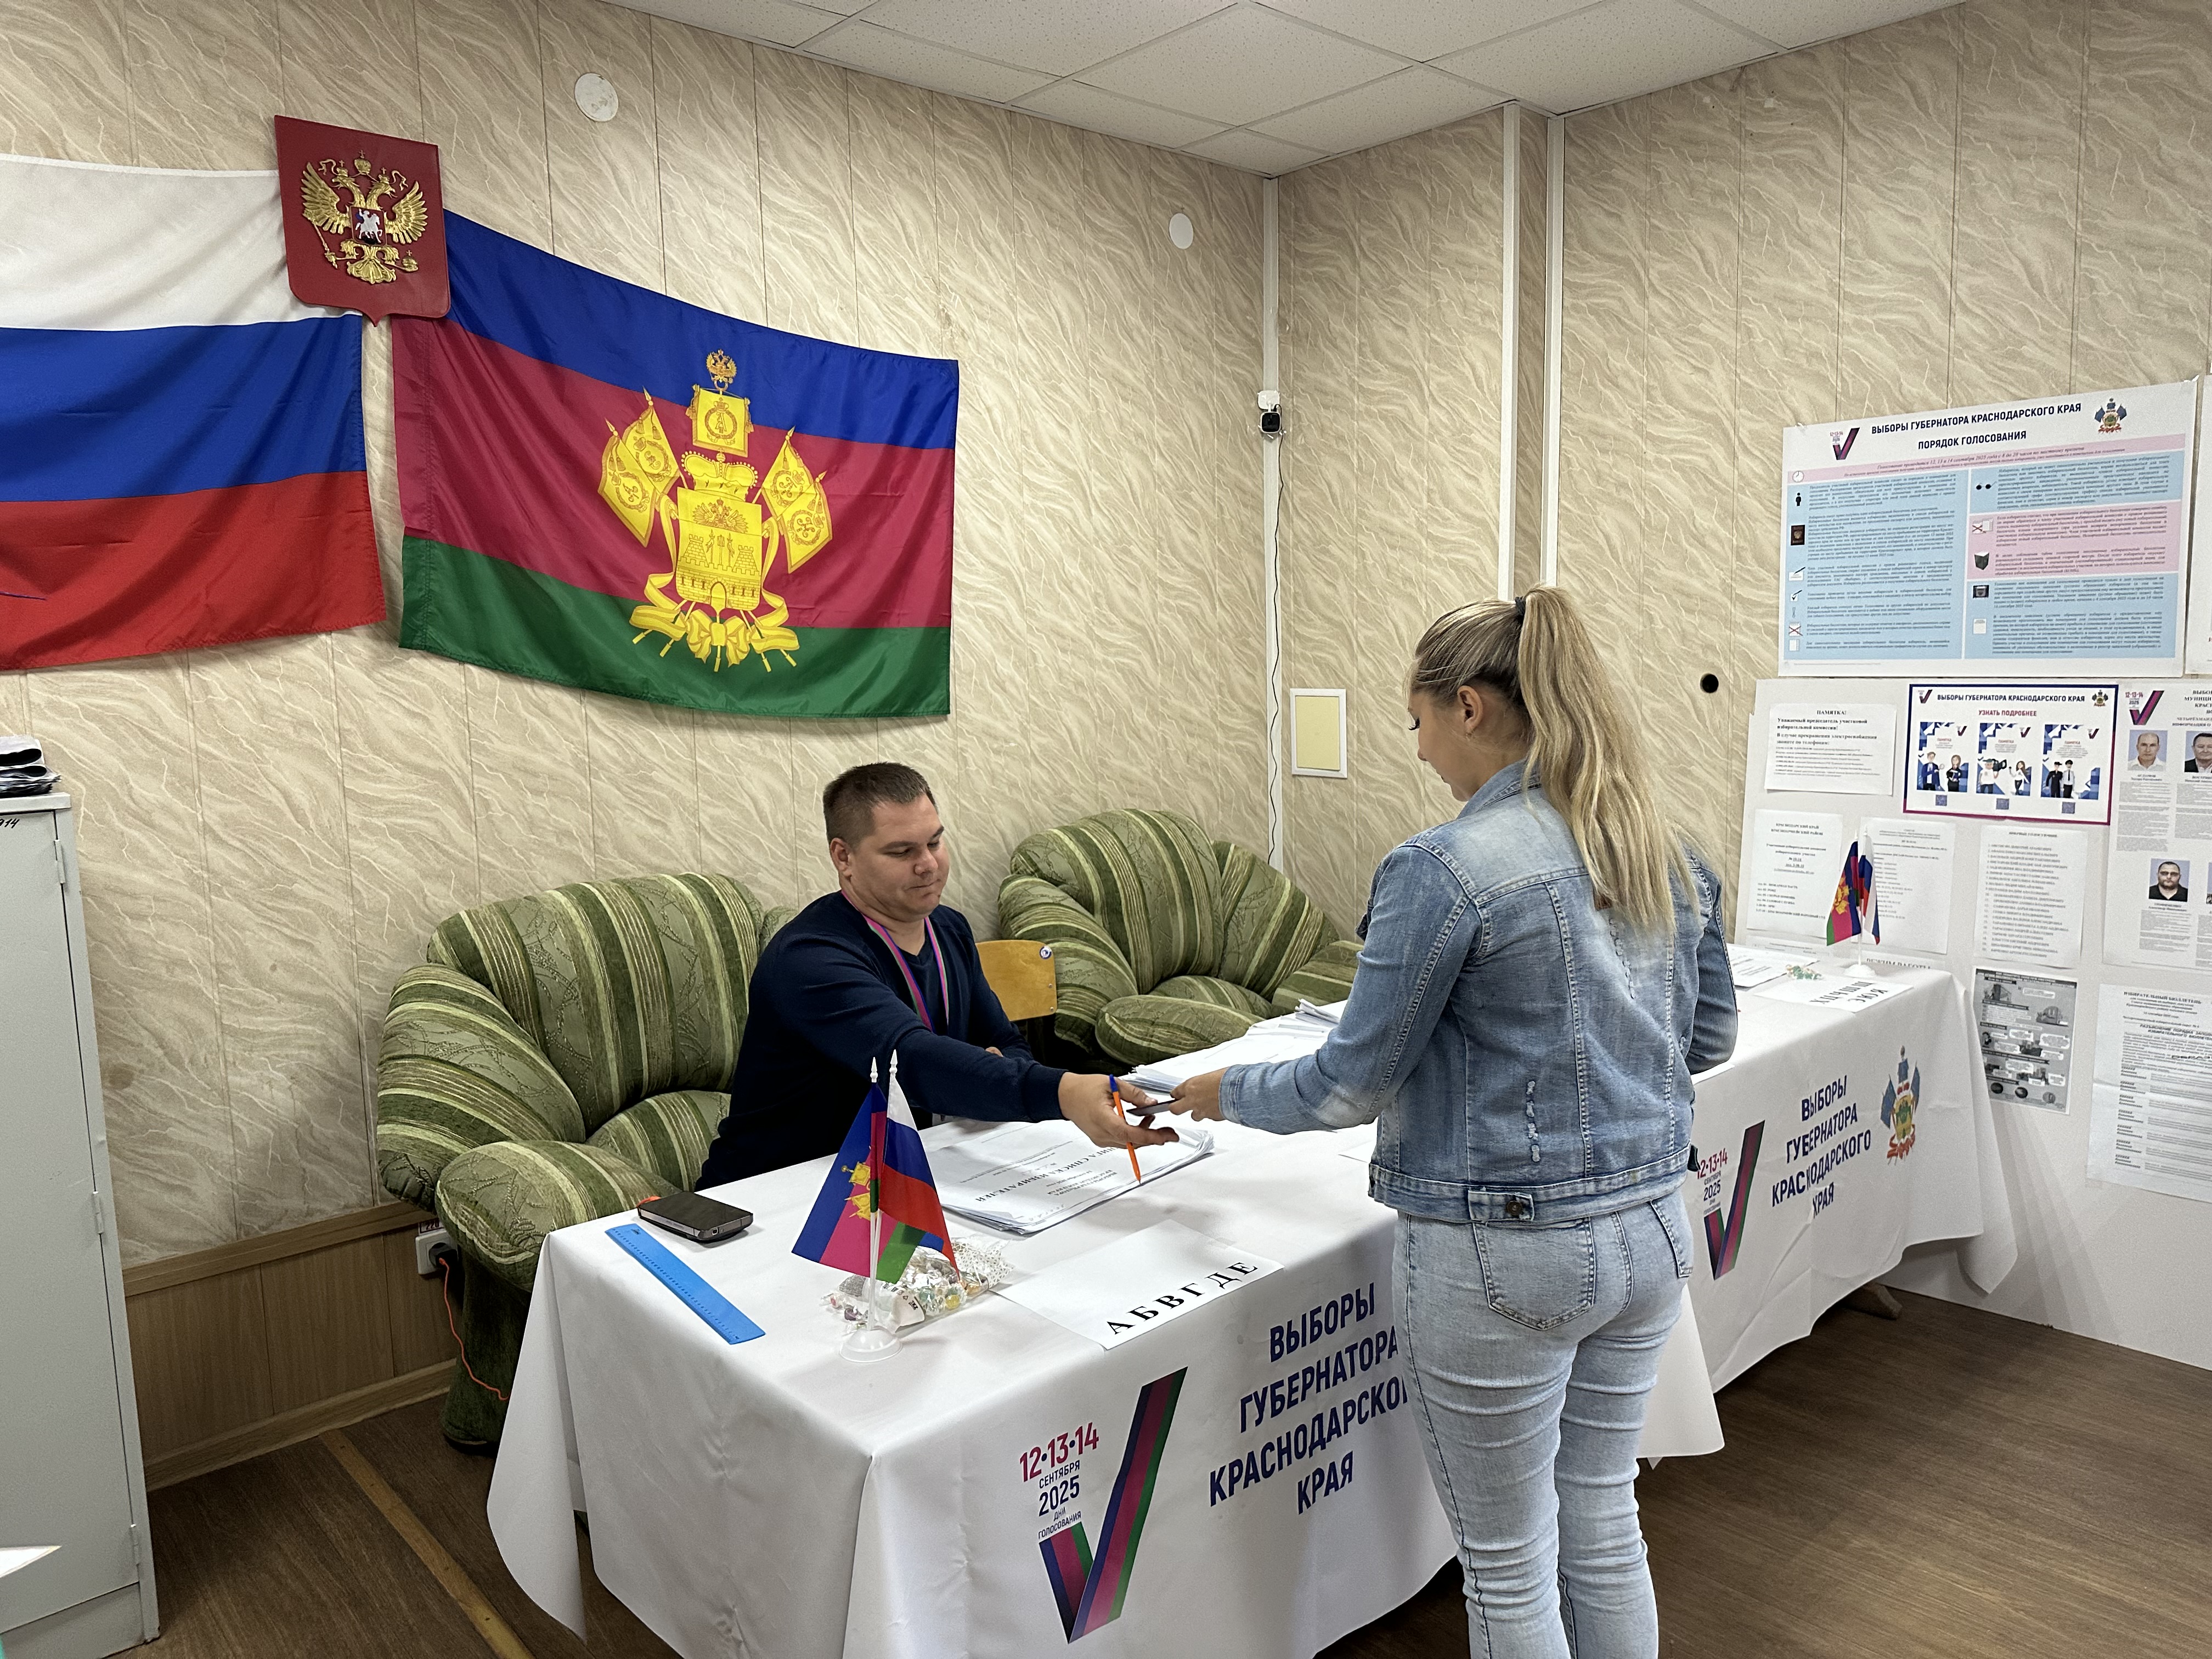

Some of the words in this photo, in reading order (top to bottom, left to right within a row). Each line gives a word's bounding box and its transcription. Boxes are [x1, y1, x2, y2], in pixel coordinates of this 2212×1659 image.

[1871, 422, 1909, 435] ВЫБОРЫ
[1911, 416, 1969, 430] ГУБЕРНАТОРА
[1971, 407, 2055, 424] КРАСНОДАРСКОГО
[2057, 403, 2081, 414] КРАЯ
[1918, 437, 1959, 450] ПОРЯДОК
[1961, 431, 2027, 445] ГОЛОСОВАНИЯ
[1802, 1075, 1847, 1122] ВЫБОРЫ
[1048, 1158, 1089, 1175] СПИСКА
[1772, 1129, 1871, 1207] КРАСНОДАРСКОГО
[975, 1173, 1049, 1202] ИЗБИРАТЕЛЕЙ
[1703, 1179, 1721, 1201] 2025
[1270, 1282, 1374, 1363] ВЫБОРЫ
[1240, 1325, 1398, 1433] ГУБЕРНАТОРА
[1210, 1375, 1408, 1507] КРАСНОДАРСКО
[1039, 1459, 1080, 1489] СЕНТЯБРЯ
[1298, 1451, 1353, 1515] КРАЯ
[1039, 1475, 1080, 1517] 2025
[1039, 1511, 1081, 1539] ГОЛОСОВАНИЯ
[1053, 1506, 1066, 1522] ДНИ
